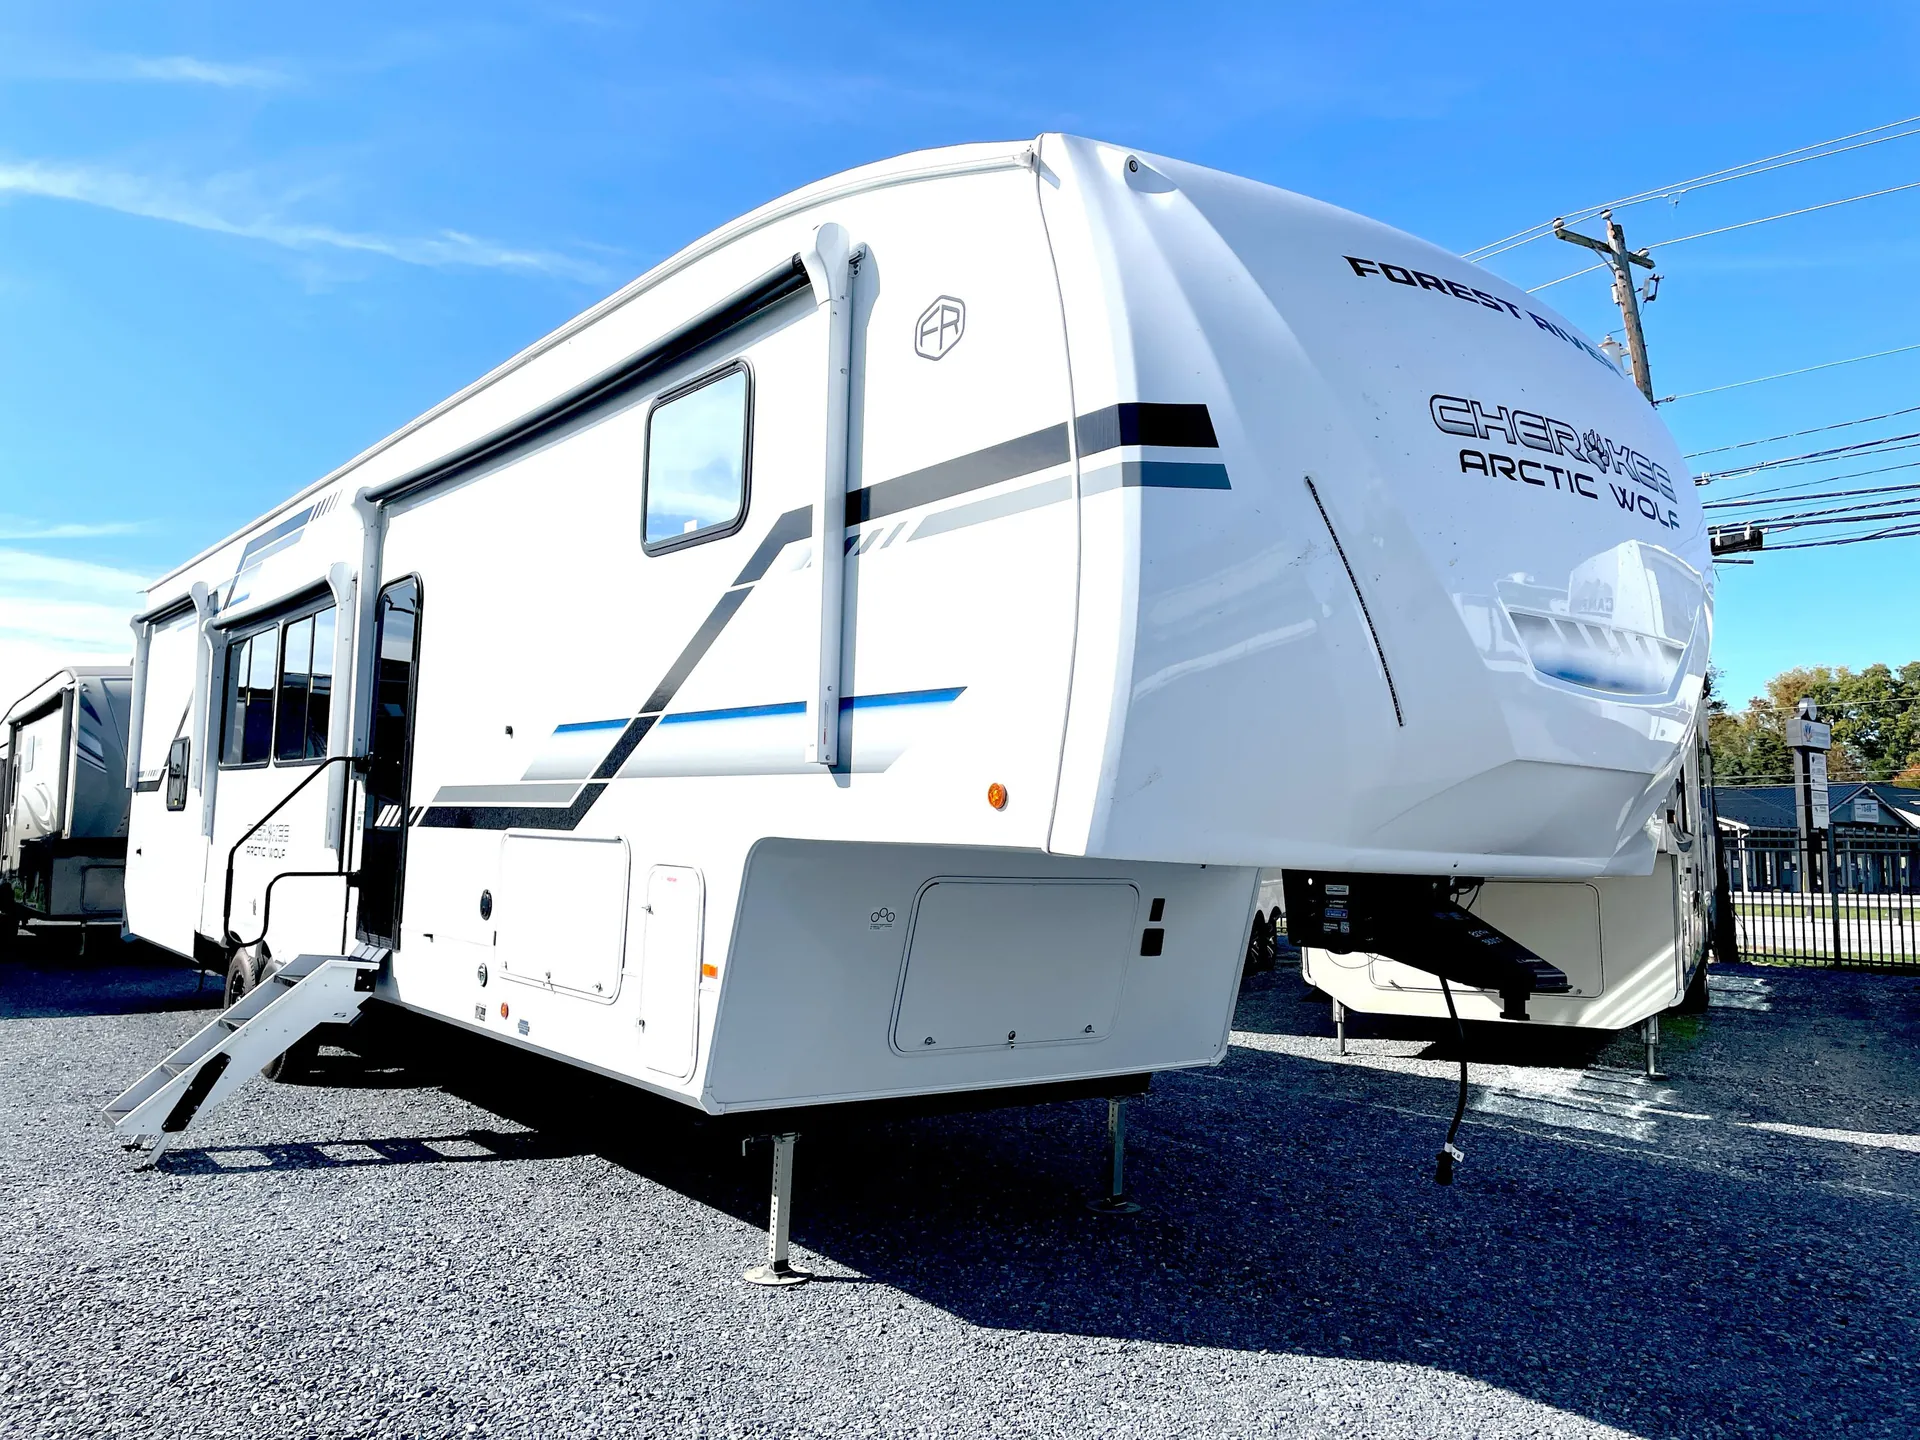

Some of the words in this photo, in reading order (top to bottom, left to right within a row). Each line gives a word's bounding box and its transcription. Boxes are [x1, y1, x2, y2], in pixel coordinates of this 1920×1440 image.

[1342, 255, 1522, 319] FOREST
[1459, 449, 1599, 500] ARCTIC
[1608, 482, 1681, 530] WOLF
